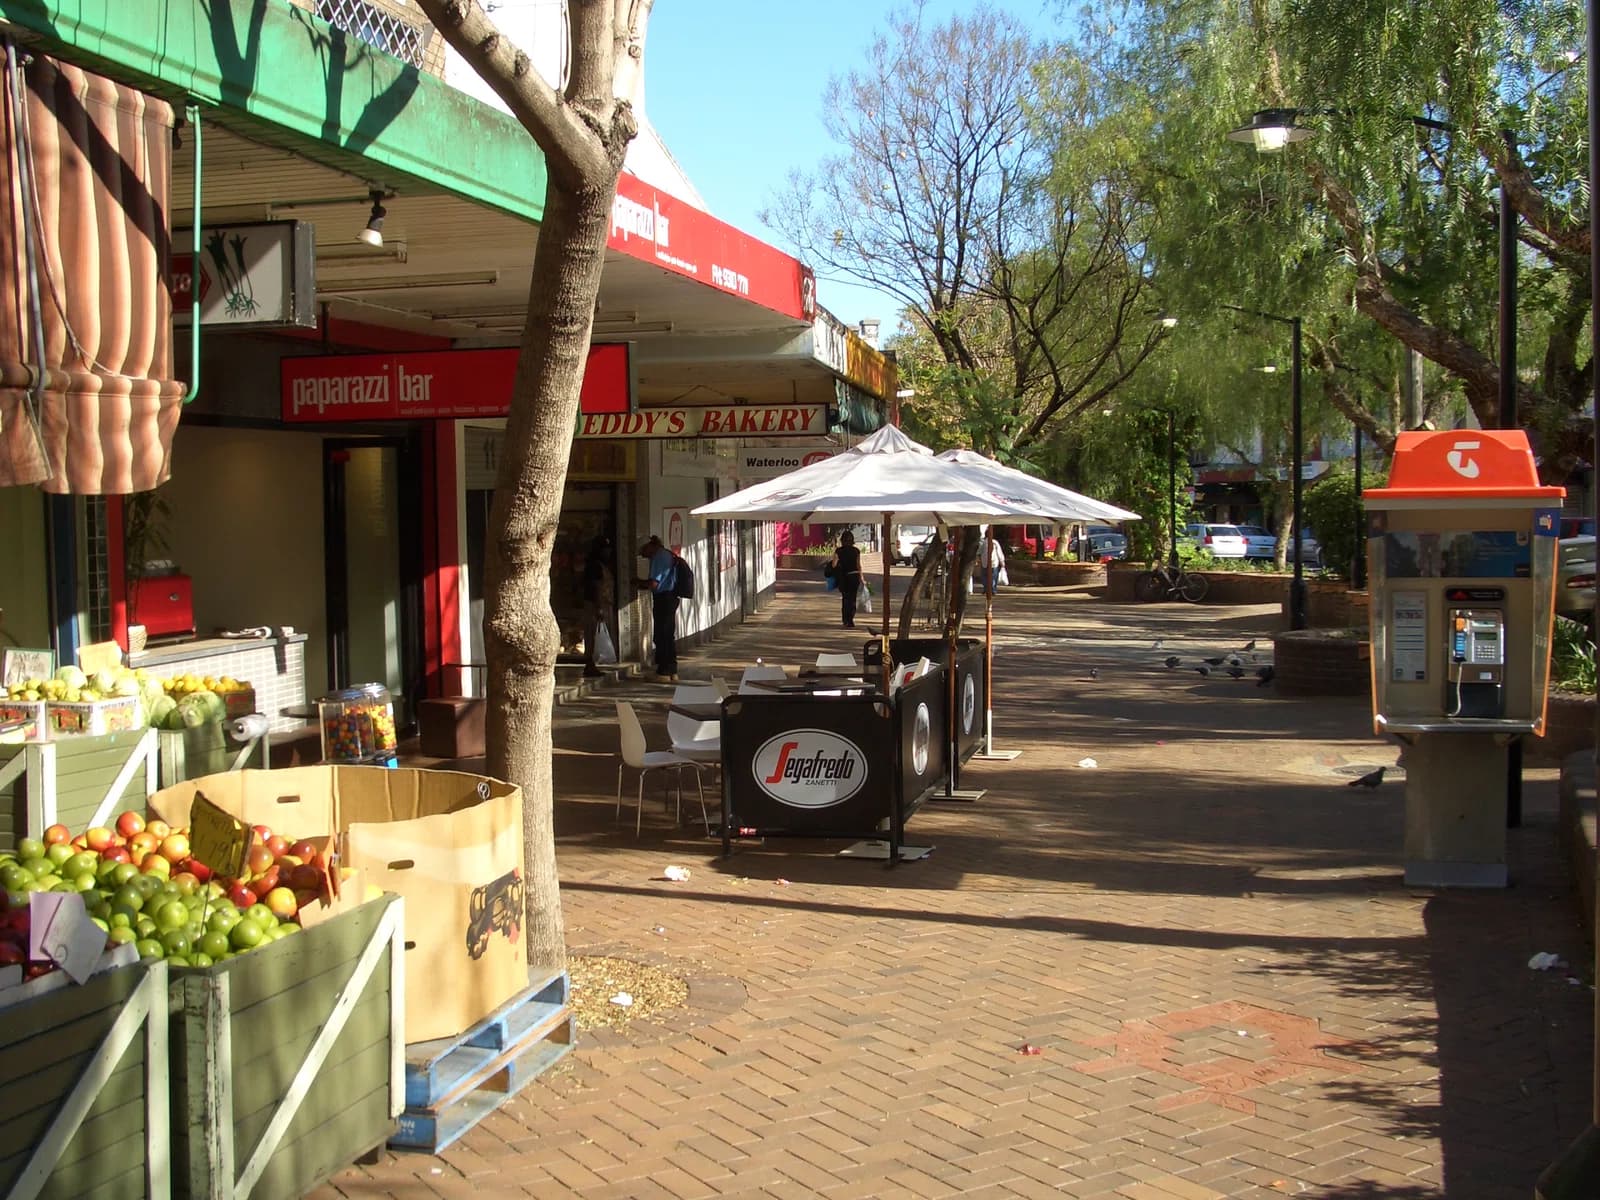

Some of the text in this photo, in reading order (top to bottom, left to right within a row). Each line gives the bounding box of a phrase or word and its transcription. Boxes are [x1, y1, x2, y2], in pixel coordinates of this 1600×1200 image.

[655, 201, 669, 248] bar
[292, 364, 433, 415] paparazzi bar
[700, 408, 818, 433] BAKERY
[745, 456, 800, 468] Waterloo
[765, 741, 855, 784] Segafredo
